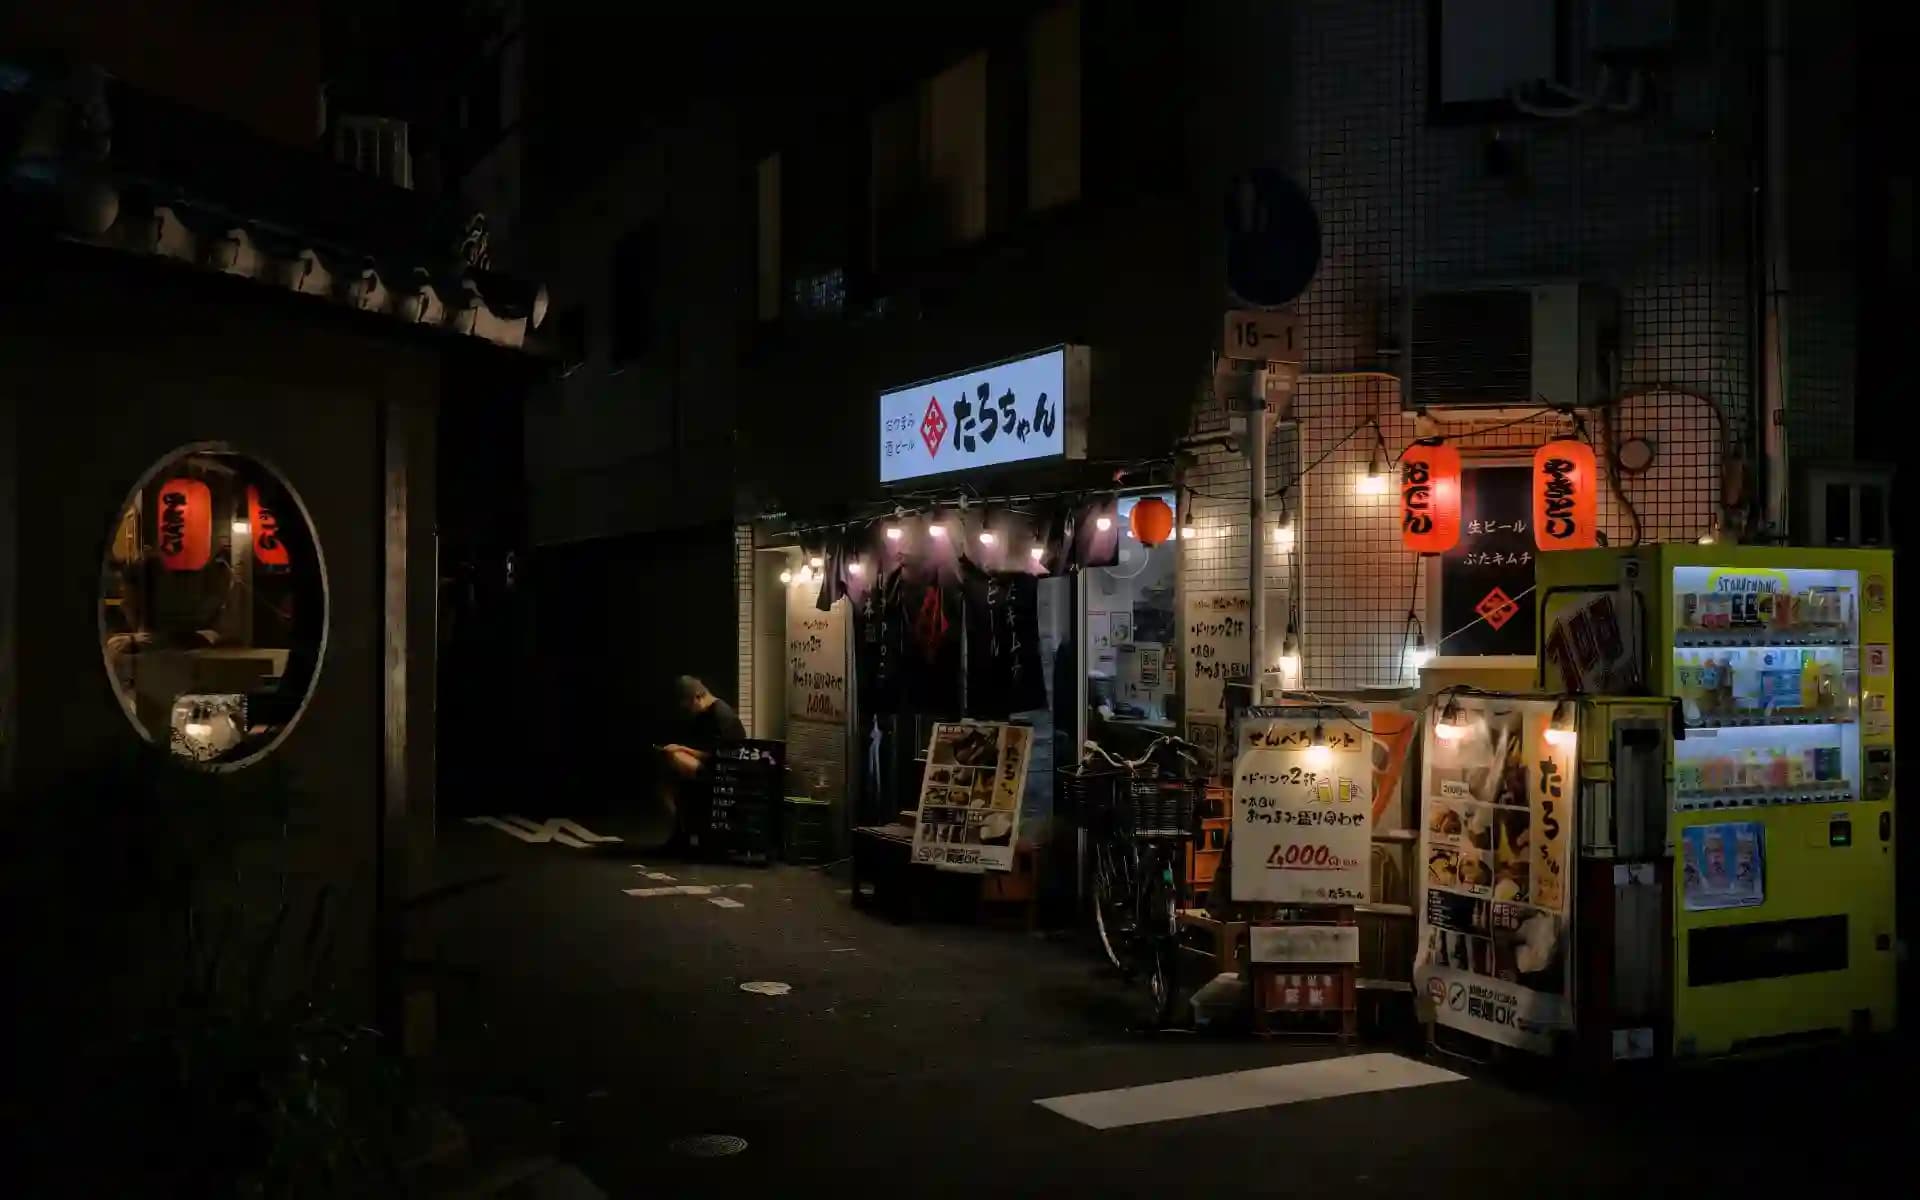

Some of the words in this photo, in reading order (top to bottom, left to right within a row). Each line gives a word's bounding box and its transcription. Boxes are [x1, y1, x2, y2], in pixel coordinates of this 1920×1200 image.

[953, 382, 1056, 453] たろちゃん
[1400, 461, 1433, 534] おでん
[1468, 519, 1527, 535] 生ビール
[1463, 551, 1534, 567] ぶたキムチ
[1248, 728, 1356, 749] せんべろット
